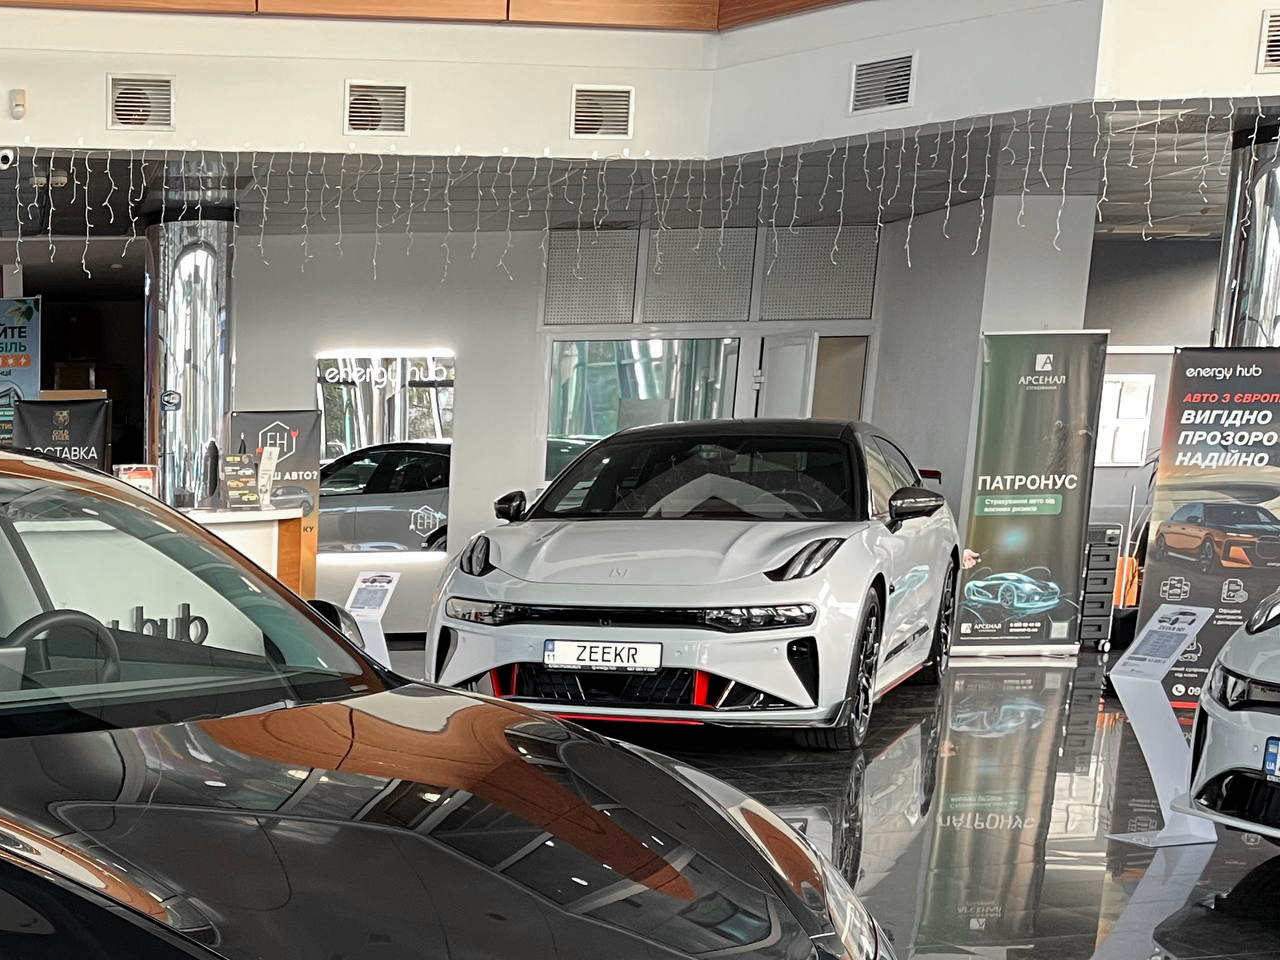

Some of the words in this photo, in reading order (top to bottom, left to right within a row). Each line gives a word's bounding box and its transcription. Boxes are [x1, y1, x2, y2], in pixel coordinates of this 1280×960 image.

[325, 365, 401, 389] energy
[409, 360, 448, 382] hub
[1018, 375, 1066, 385] АРСЕНАЛ
[1185, 367, 1233, 380] energy
[1236, 364, 1263, 377] hub
[1183, 393, 1219, 403] АВТО
[1180, 409, 1273, 428] ВИГІДНО
[1178, 430, 1279, 446] ПРОЗОРО
[1175, 448, 1270, 469] НАДІЙНО
[284, 471, 318, 480] АВТО?
[977, 474, 1078, 491] ПАТРОНУС
[576, 645, 638, 663] ZEEKR
[1187, 686, 1201, 696] 09
[1266, 760, 1276, 770] UA
